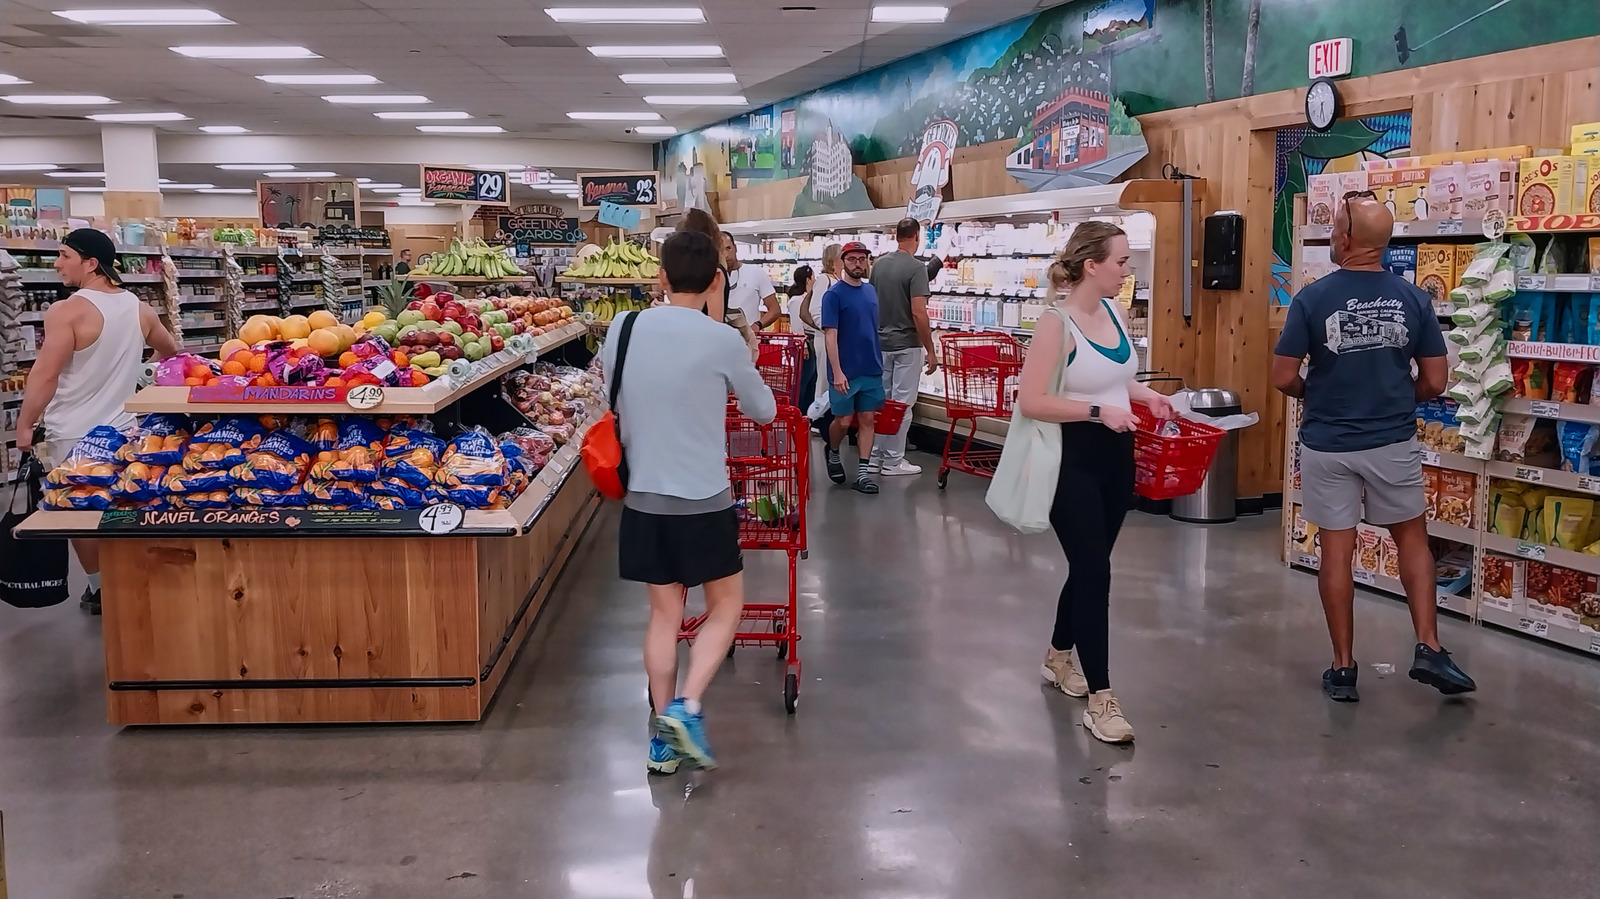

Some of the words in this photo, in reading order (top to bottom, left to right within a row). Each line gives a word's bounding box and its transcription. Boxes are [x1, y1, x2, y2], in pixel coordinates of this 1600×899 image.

[1315, 41, 1341, 75] EXIT
[750, 113, 771, 136] Dairy
[425, 170, 475, 186] ORGANIC
[525, 172, 539, 183] EXIT
[1521, 170, 1539, 187] JOE'S
[426, 183, 469, 195] Bananas
[479, 173, 502, 198] 29
[585, 181, 629, 203] Bananas
[635, 179, 653, 203] 23
[507, 218, 568, 230] GREETING
[513, 229, 563, 240] CARDS
[1346, 297, 1403, 311] Beachcity
[243, 386, 336, 400] MANDARINS
[81, 435, 112, 449] NAVEL
[77, 442, 115, 459] RANGES
[139, 511, 200, 526] NAVEL
[203, 511, 280, 524] ORANGES
